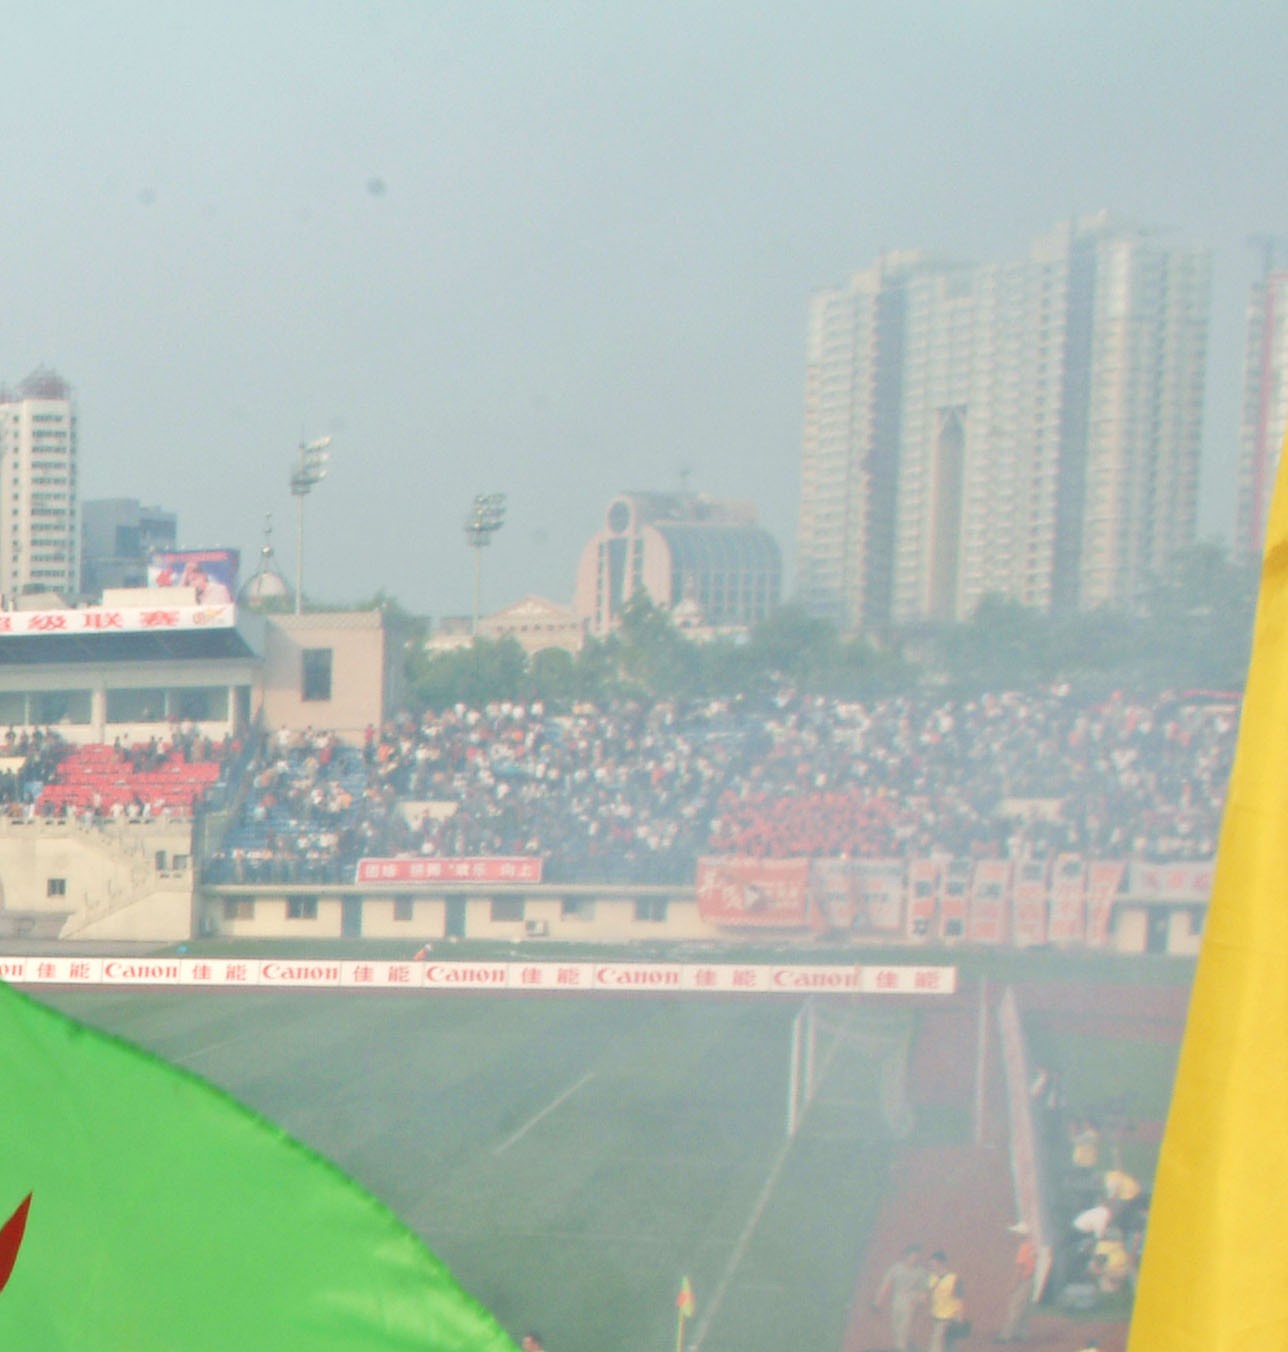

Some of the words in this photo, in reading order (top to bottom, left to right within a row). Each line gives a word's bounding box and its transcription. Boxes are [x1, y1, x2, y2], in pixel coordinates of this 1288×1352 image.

[36, 962, 91, 979] 佳能
[104, 962, 178, 978] Canon
[191, 963, 247, 981] 佳能
[262, 963, 338, 980] Canon
[353, 964, 410, 983] 佳能
[426, 965, 506, 983] Canon
[520, 966, 581, 985] 佳能
[596, 967, 680, 985] Canon
[695, 968, 757, 987] 佳能
[772, 968, 859, 987] Canon
[875, 970, 940, 990] 佳能
